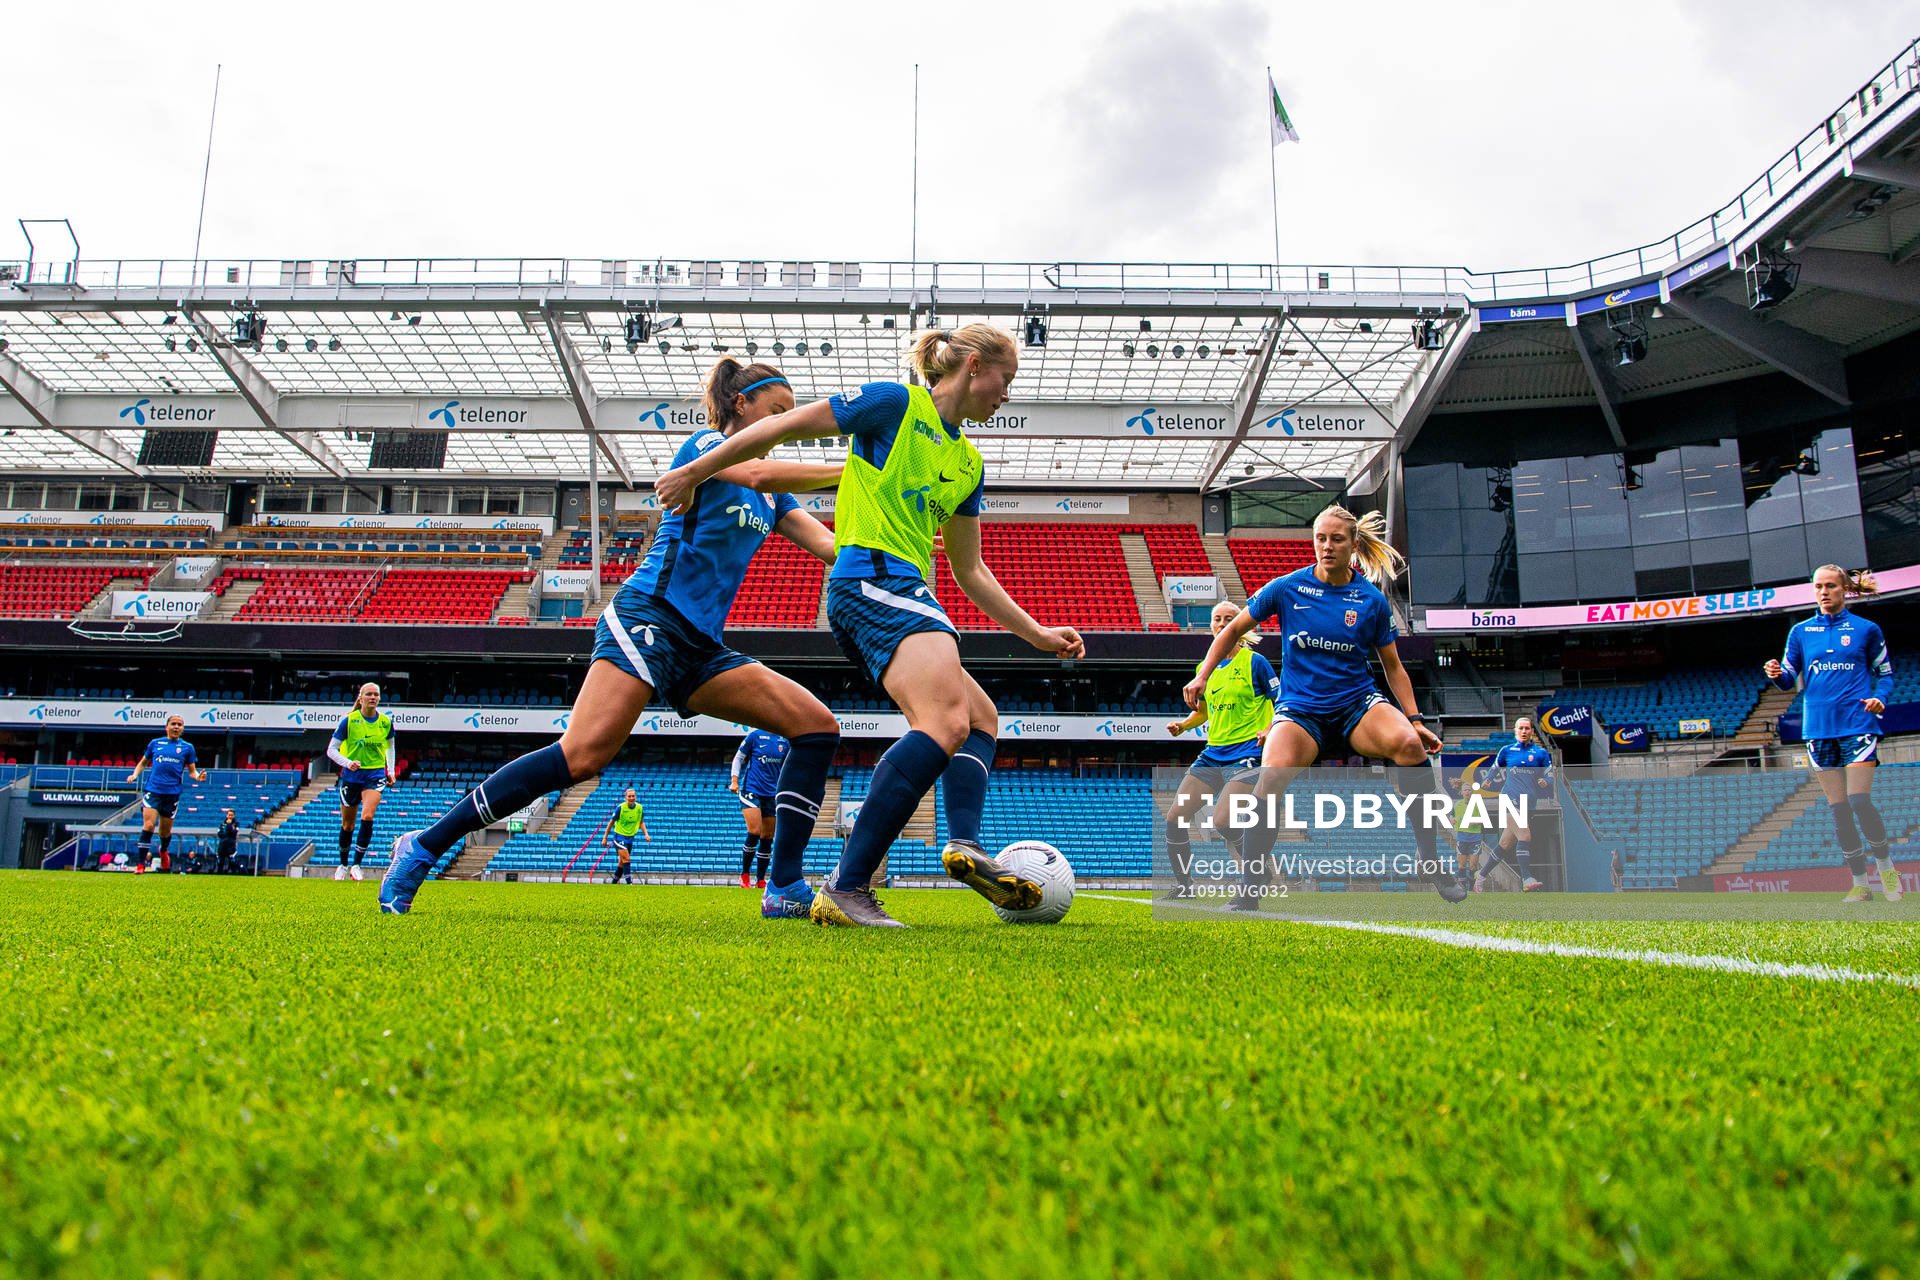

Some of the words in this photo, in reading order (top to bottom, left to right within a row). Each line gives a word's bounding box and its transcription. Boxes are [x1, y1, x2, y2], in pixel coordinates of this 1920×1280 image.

[149, 404, 216, 421] telenor
[459, 406, 528, 423] telenor
[670, 408, 706, 425] tele
[1157, 413, 1226, 431] telenor
[1297, 414, 1366, 431] telenor
[986, 499, 1020, 509] telenor
[1069, 499, 1103, 509] telenor
[30, 515, 62, 525] telenor
[103, 516, 136, 526] telenor
[177, 516, 210, 526] telenor
[277, 518, 310, 528] telenor
[353, 518, 386, 528] telenor
[430, 519, 463, 529] telenor
[506, 521, 540, 530] telenor
[747, 511, 770, 535] tele
[559, 576, 590, 585] telenor
[1182, 583, 1213, 592] telenor
[1297, 585, 1316, 596] KIWI
[147, 597, 200, 612] telenor
[1586, 604, 1630, 623] EAT
[1633, 598, 1701, 619] MOVE
[1705, 588, 1776, 612] SLEEP
[1306, 636, 1355, 652] telenor
[1818, 661, 1855, 671] telenor
[44, 707, 82, 718] telenor
[130, 706, 167, 719] telenor
[216, 708, 254, 721] telenor
[303, 711, 341, 722] telenor
[391, 711, 430, 724] telenor
[1553, 706, 1590, 728] Bendit
[480, 714, 519, 725] telenor
[659, 717, 698, 728] telenor
[840, 719, 880, 730] telenor
[1021, 721, 1060, 733] telenor
[1112, 722, 1151, 734] telenor
[1682, 723, 1698, 732] 223
[1621, 727, 1643, 740] Bendit
[43, 793, 83, 802] ULLEVAAL
[84, 794, 120, 803] STADION
